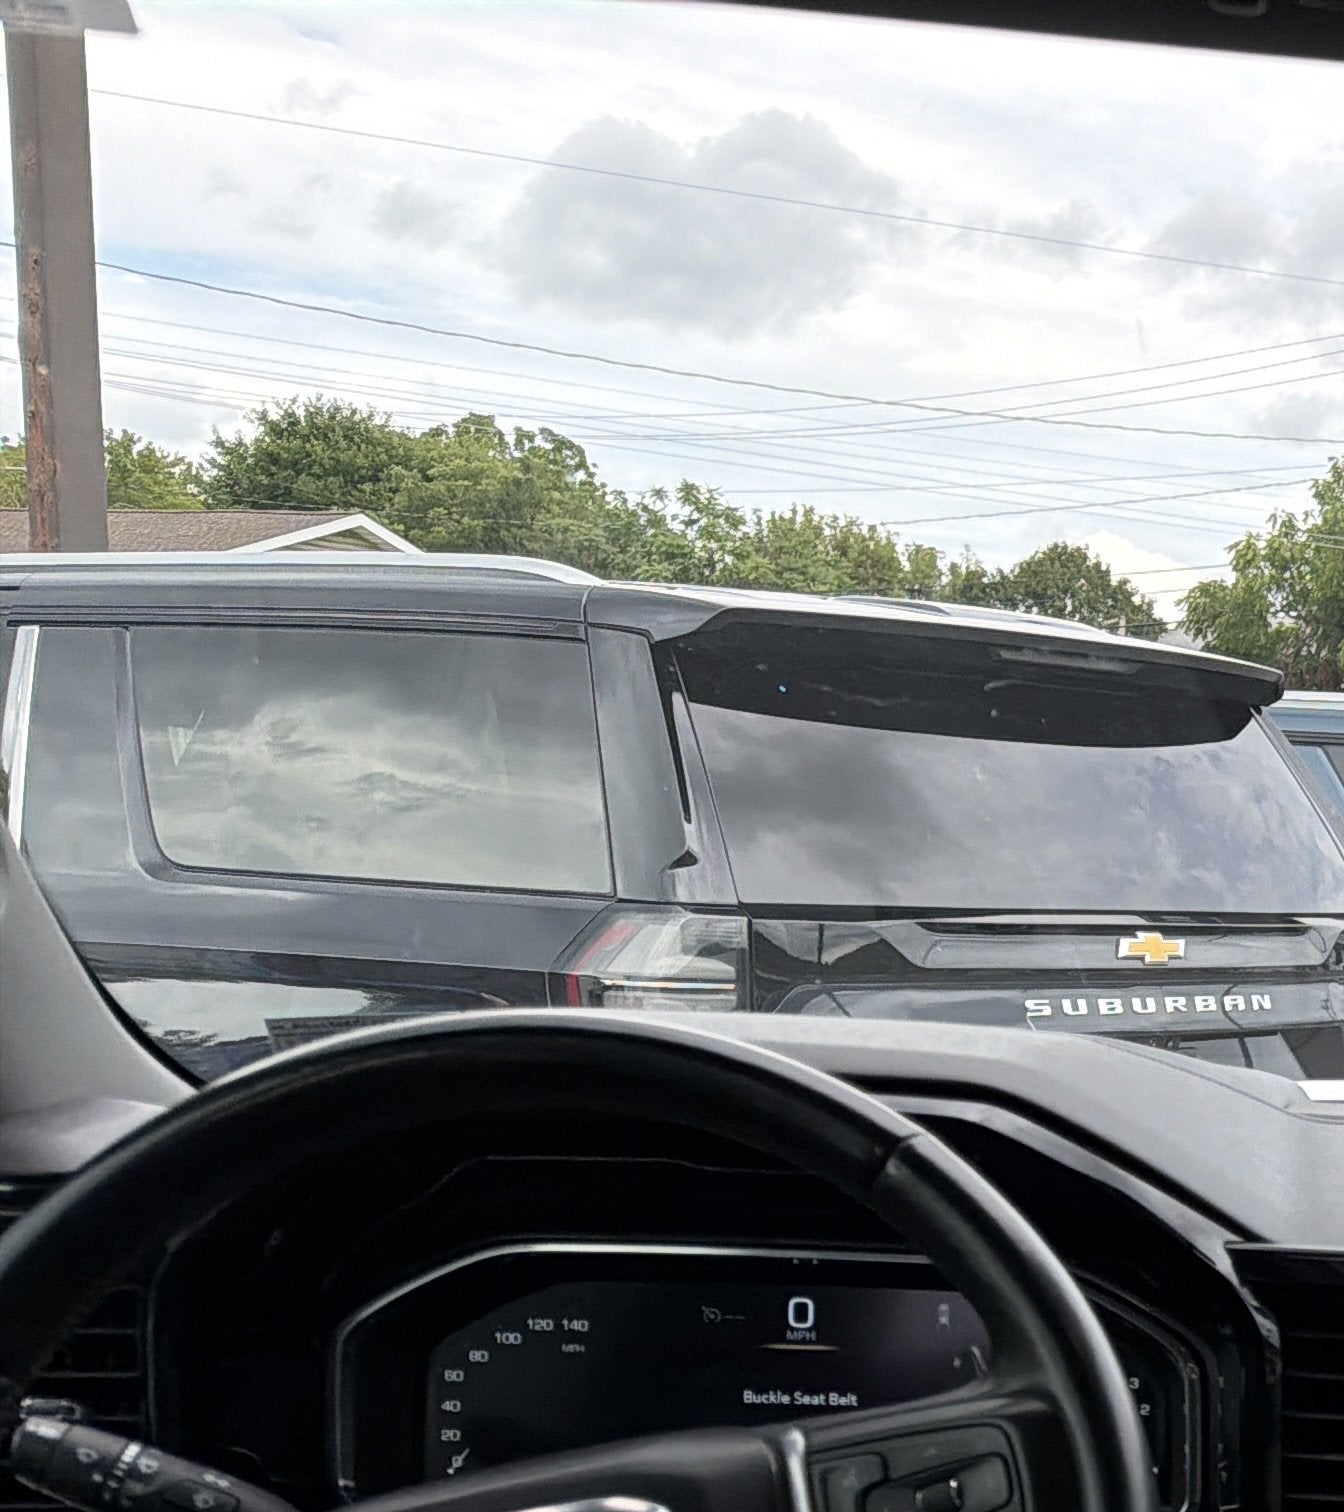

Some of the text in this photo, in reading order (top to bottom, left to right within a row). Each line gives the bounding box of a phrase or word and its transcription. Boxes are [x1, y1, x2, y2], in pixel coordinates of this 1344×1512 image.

[1024, 994, 1272, 1017] SUBURBAN
[787, 1297, 815, 1329] 0
[526, 1318, 589, 1332] 120 140
[495, 1331, 522, 1344] 100
[786, 1331, 817, 1341] MPH
[469, 1350, 489, 1362] 80
[445, 1370, 464, 1382] 60
[743, 1389, 859, 1407] Buckle Seat Belt
[441, 1400, 461, 1412] 40
[441, 1430, 461, 1441] 20
